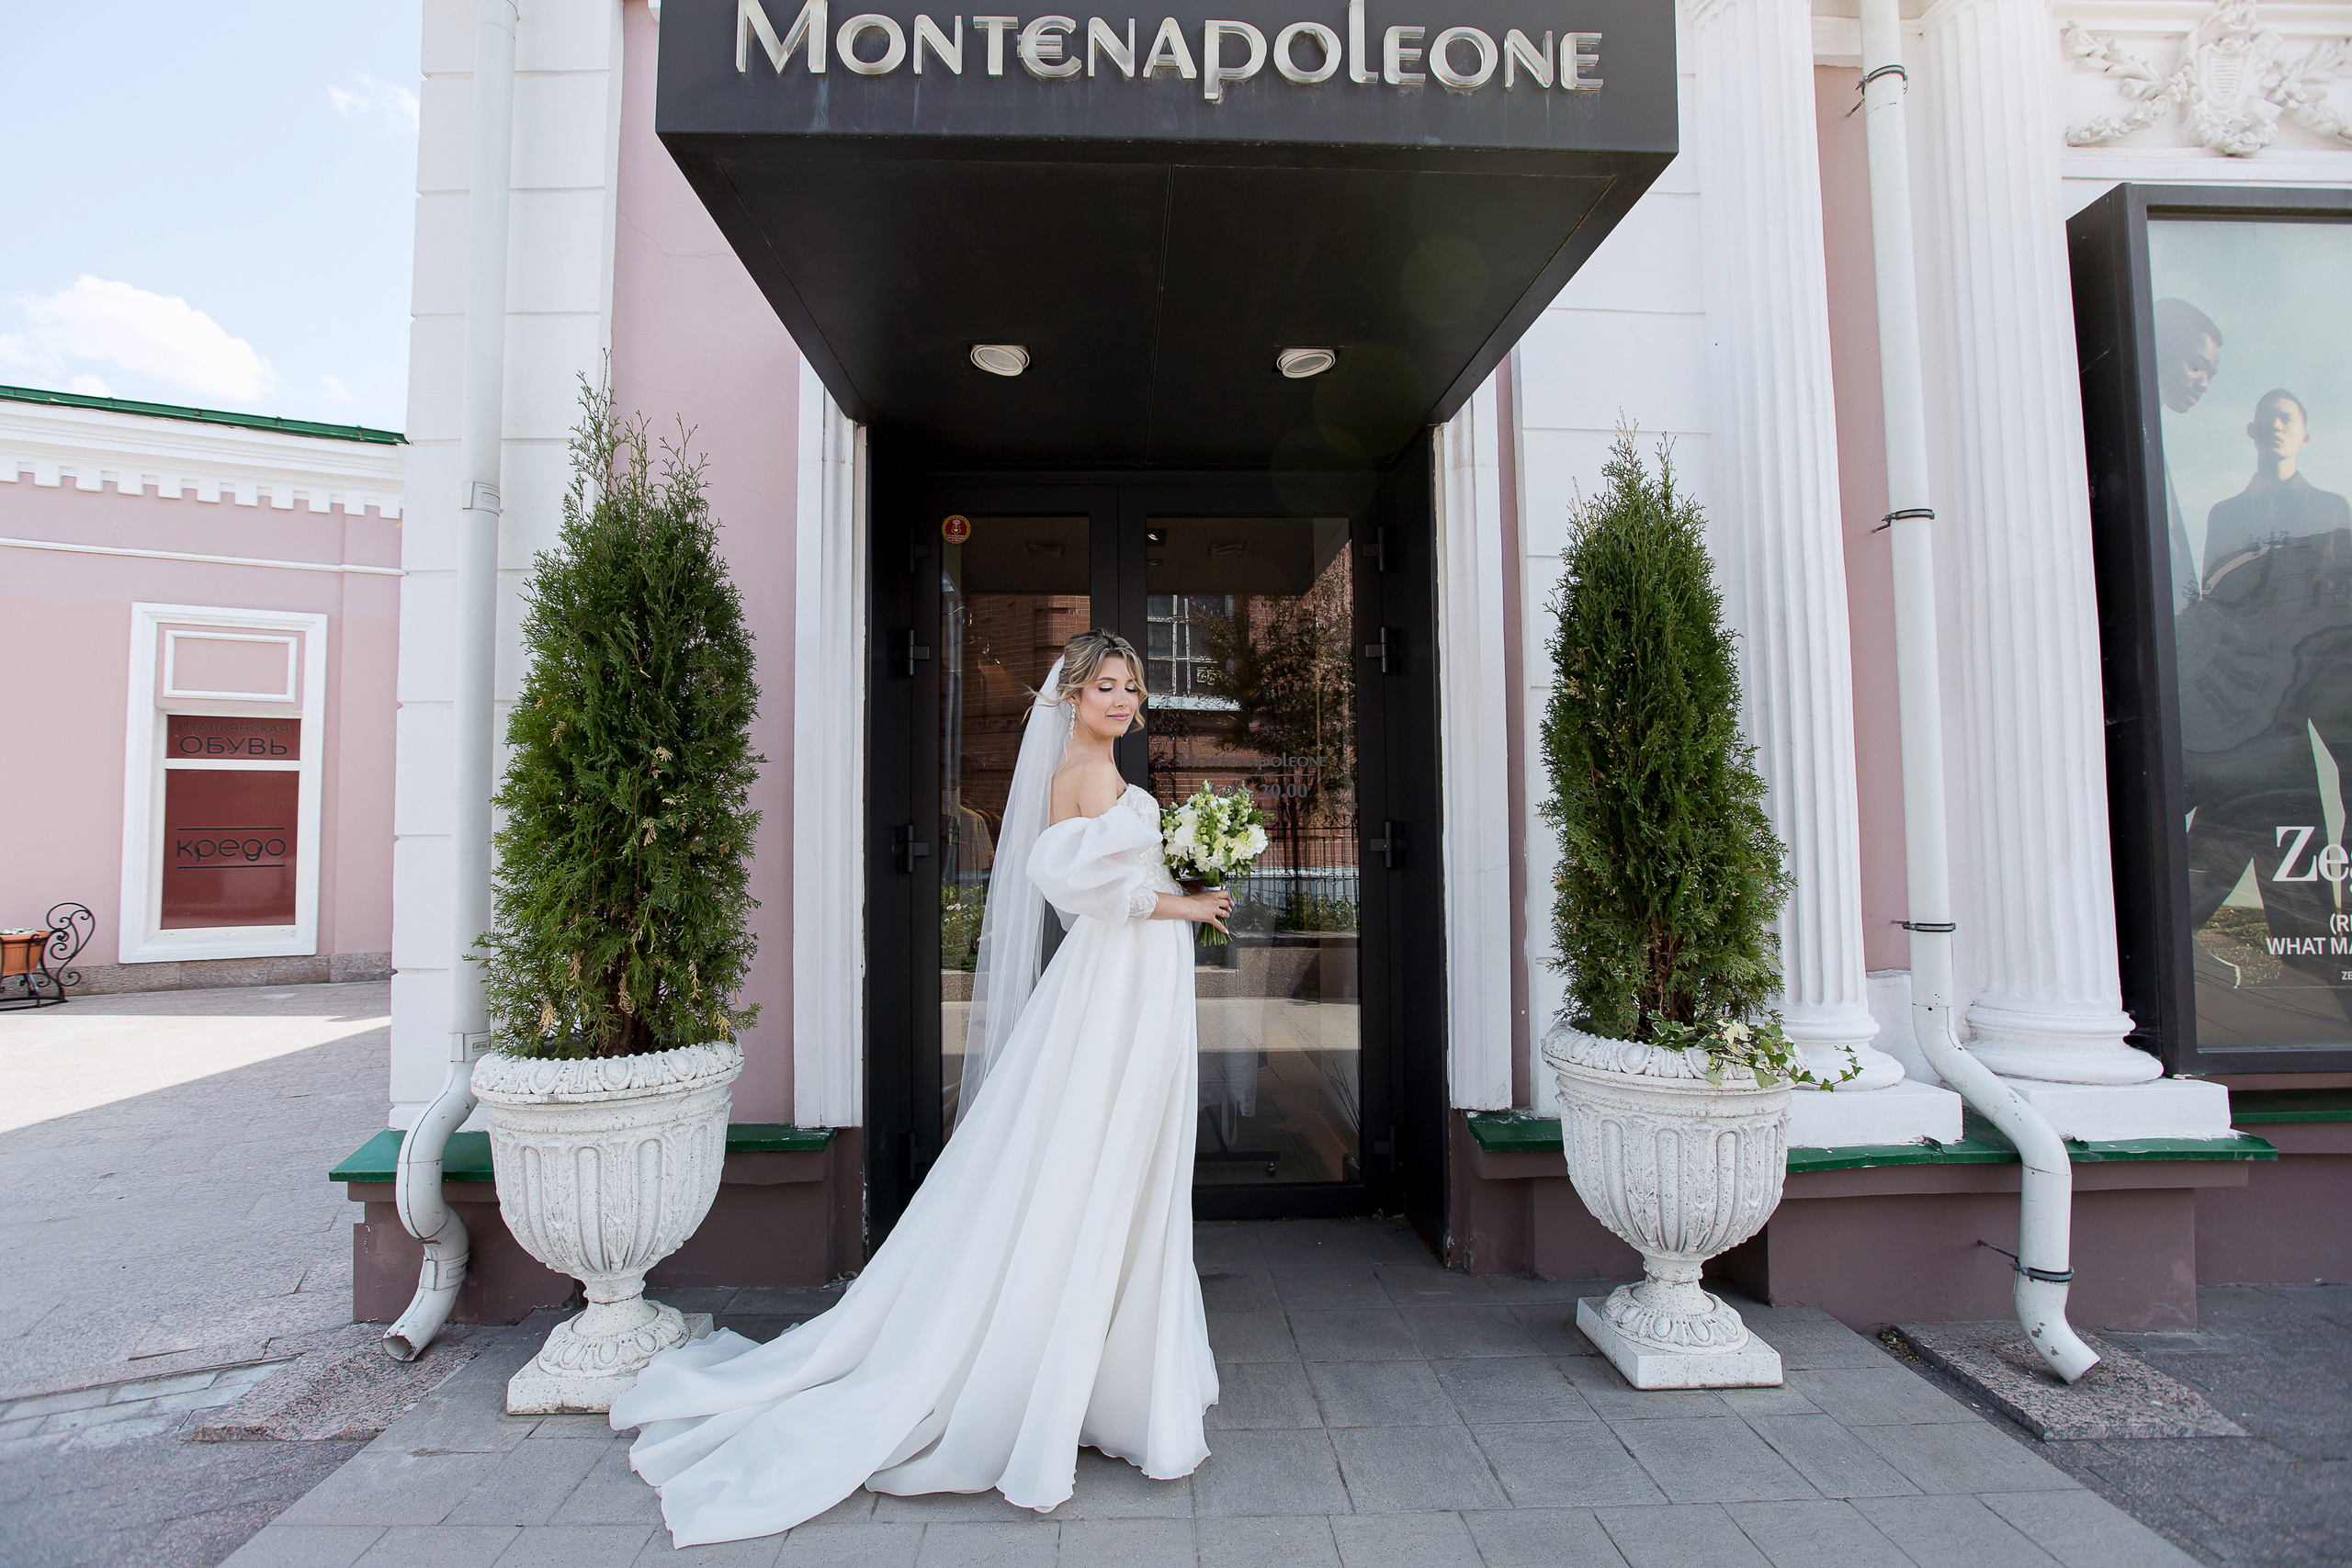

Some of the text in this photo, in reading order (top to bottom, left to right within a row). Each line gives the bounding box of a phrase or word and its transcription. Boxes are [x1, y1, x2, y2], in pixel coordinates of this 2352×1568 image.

[179, 722, 289, 733] ИТАЛЬЯНСКАЯ
[179, 736, 288, 755] ОБУВЬ
[1260, 784, 1307, 798] 20.00
[177, 838, 287, 862] кредо
[2272, 826, 2352, 894] Ze
[2266, 937, 2326, 955] WHAT
